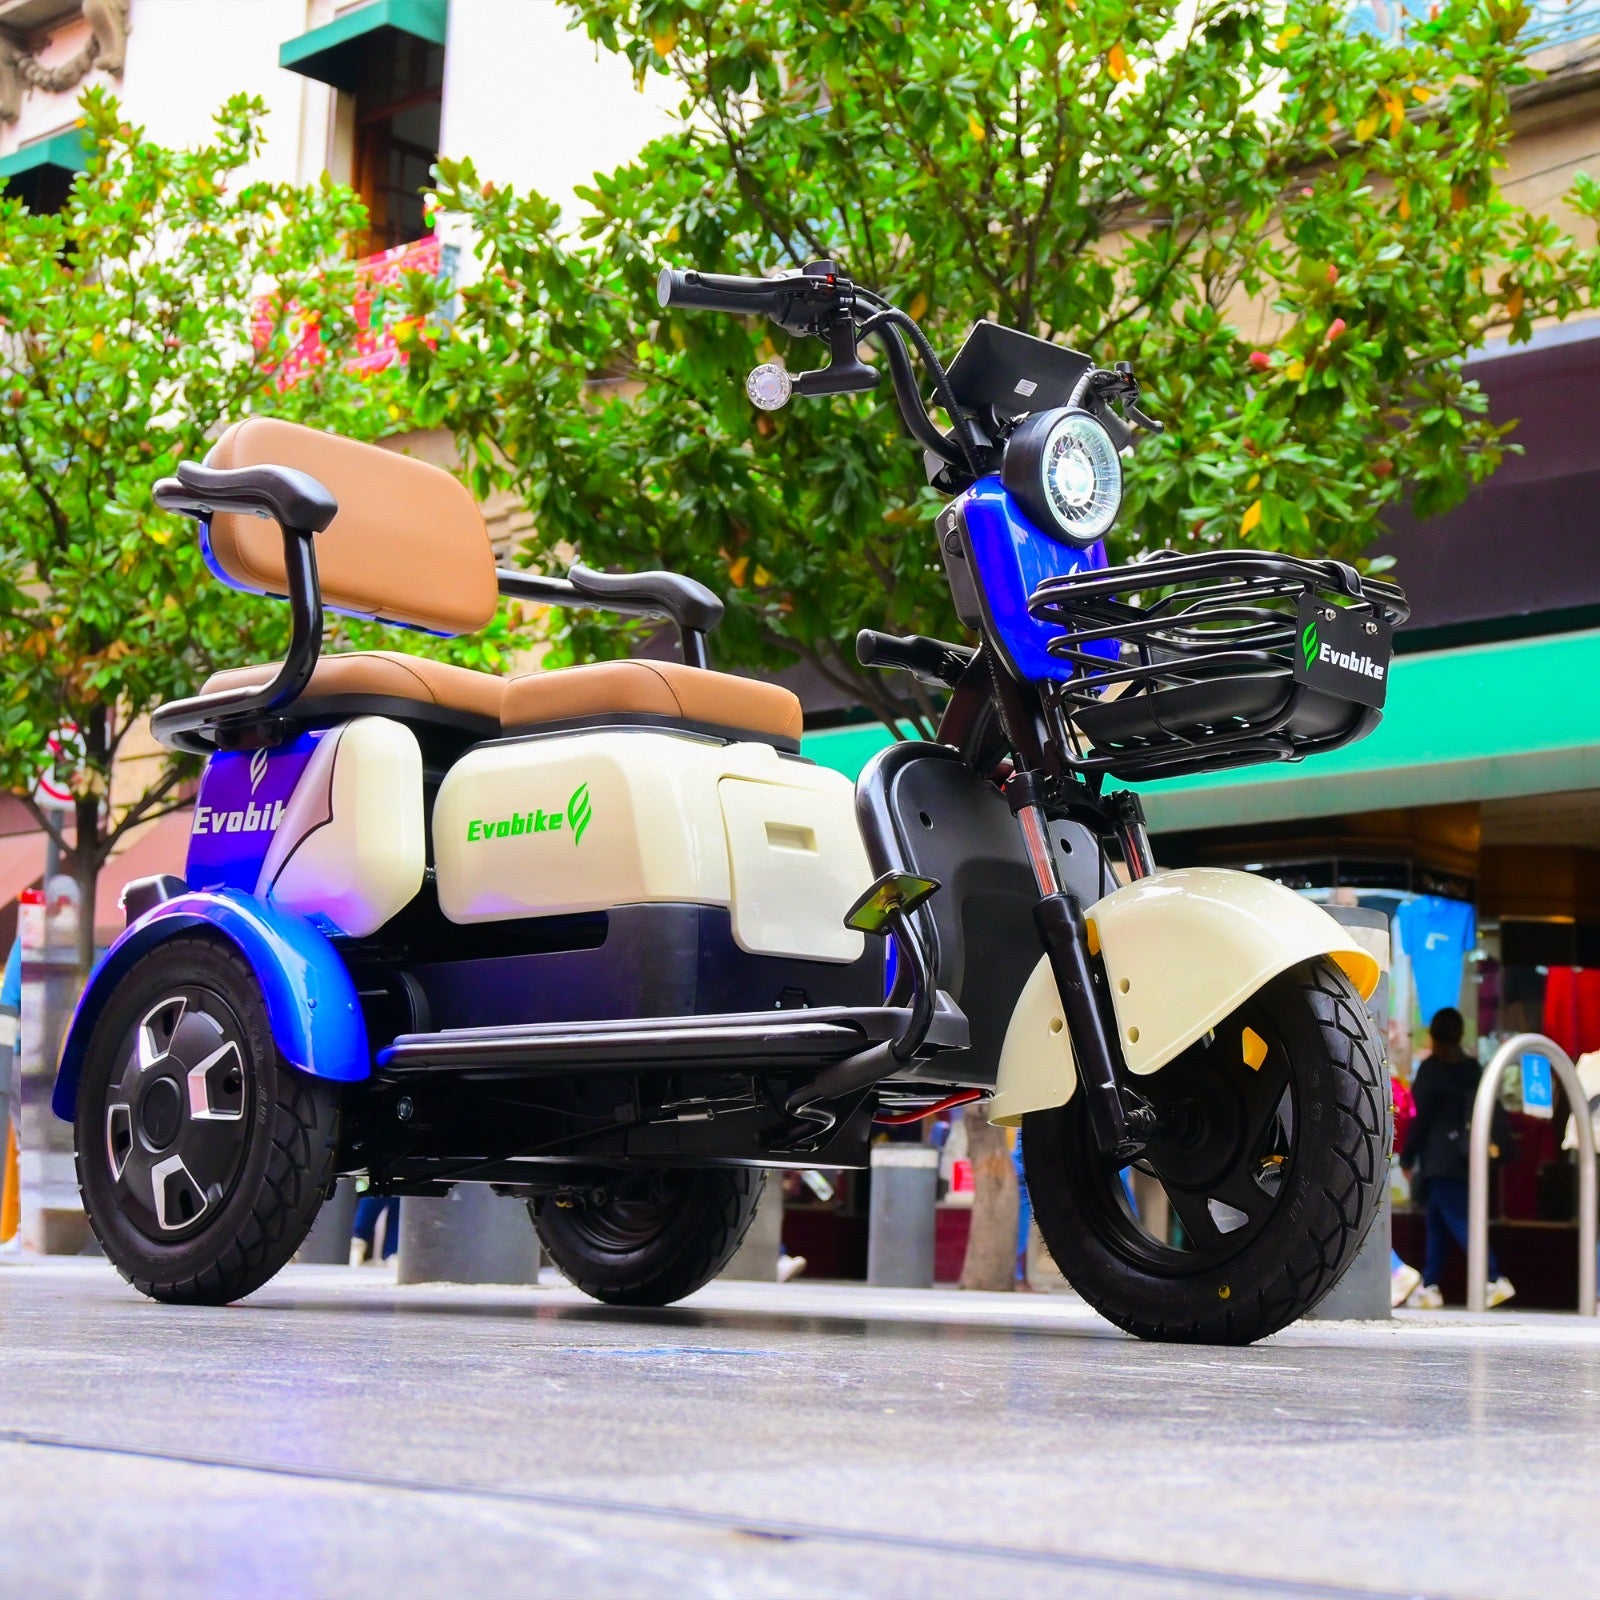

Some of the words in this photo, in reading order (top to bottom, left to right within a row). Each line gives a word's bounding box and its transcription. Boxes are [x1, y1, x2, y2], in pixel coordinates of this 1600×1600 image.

[1319, 642, 1385, 681] Evobike
[192, 799, 287, 834] Evobik
[467, 808, 564, 842] Evobike
